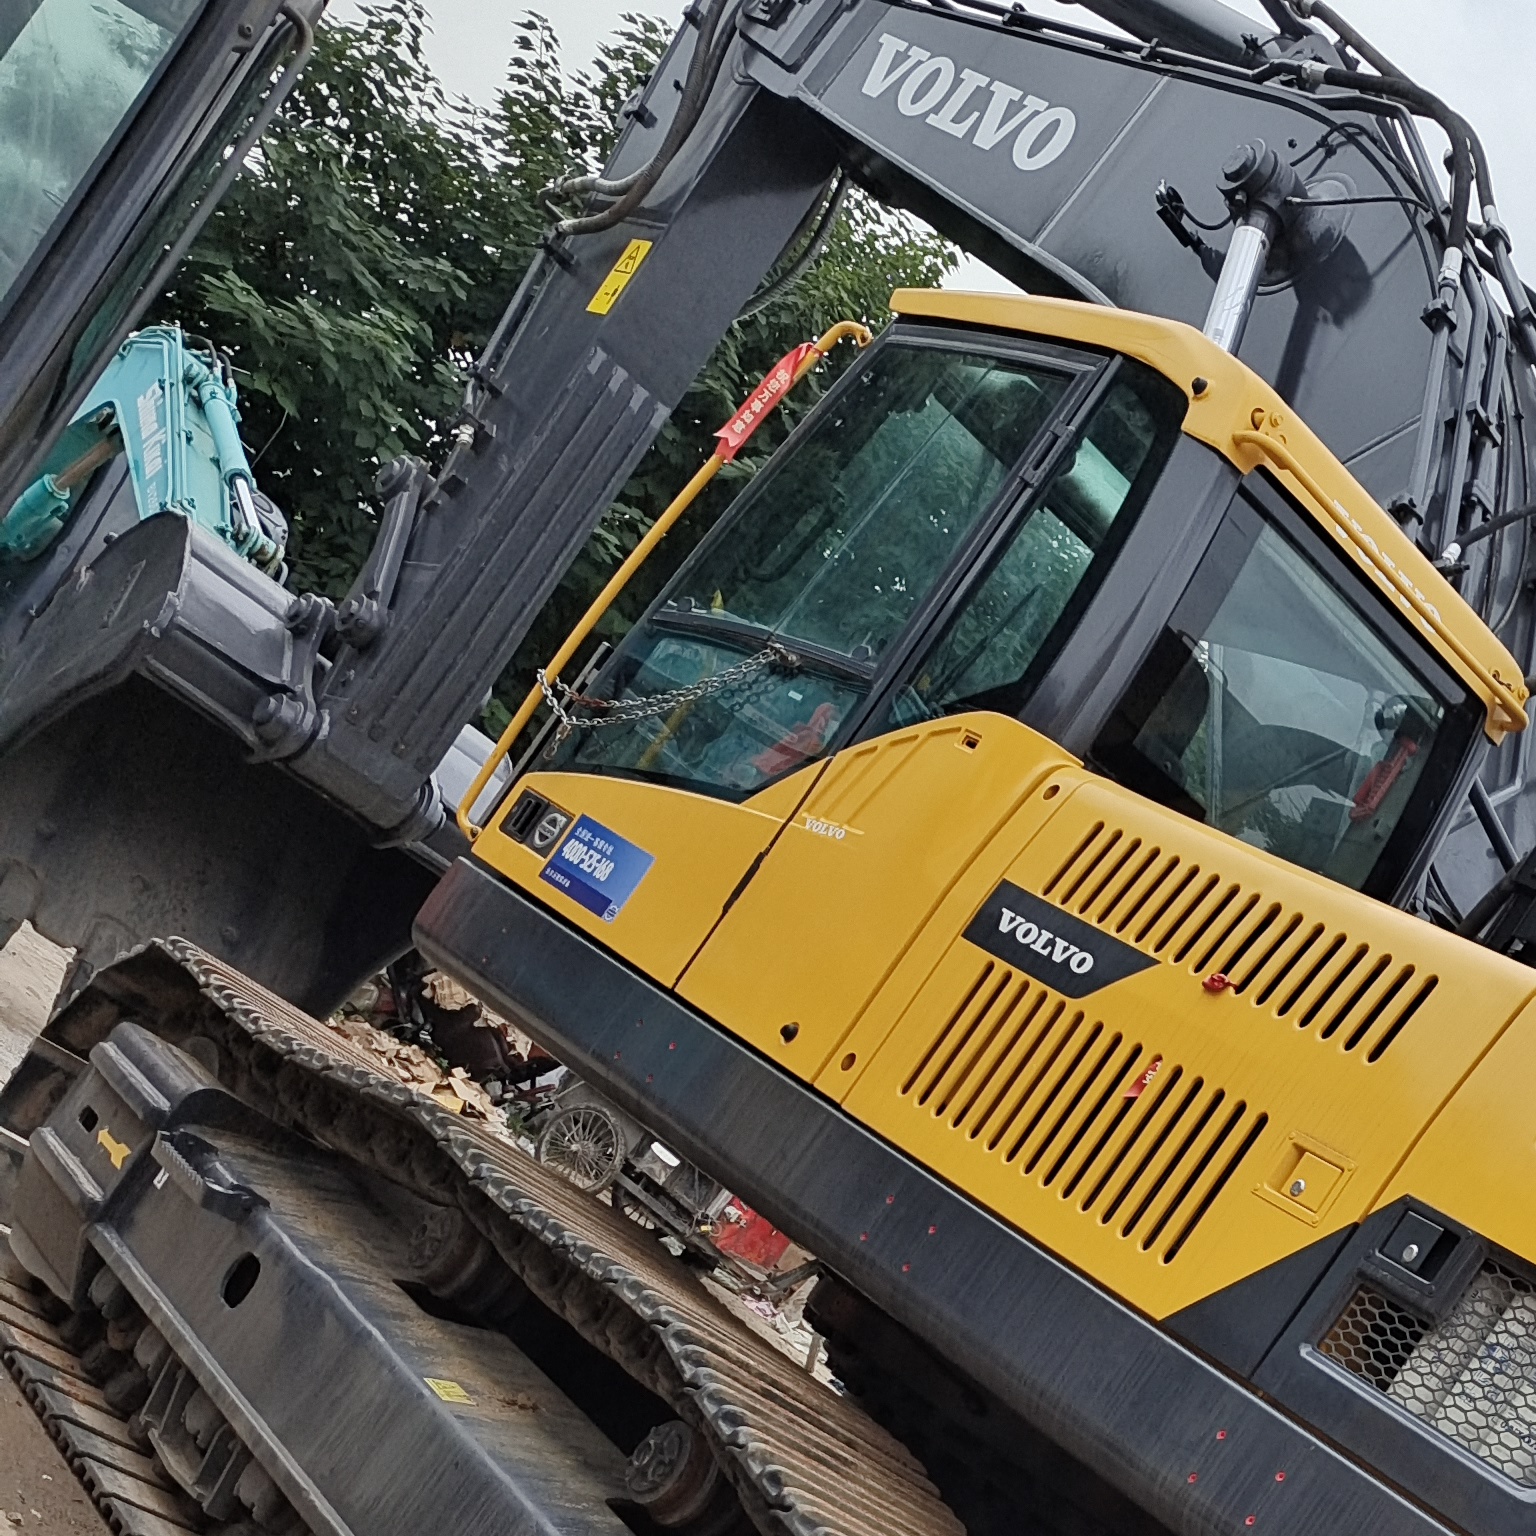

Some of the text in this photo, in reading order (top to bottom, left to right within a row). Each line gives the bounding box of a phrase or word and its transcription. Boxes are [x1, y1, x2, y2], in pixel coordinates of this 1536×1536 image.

[861, 33, 1078, 171] VOLVO
[805, 817, 846, 840] VOLVO
[999, 907, 1094, 974] VOLVO
